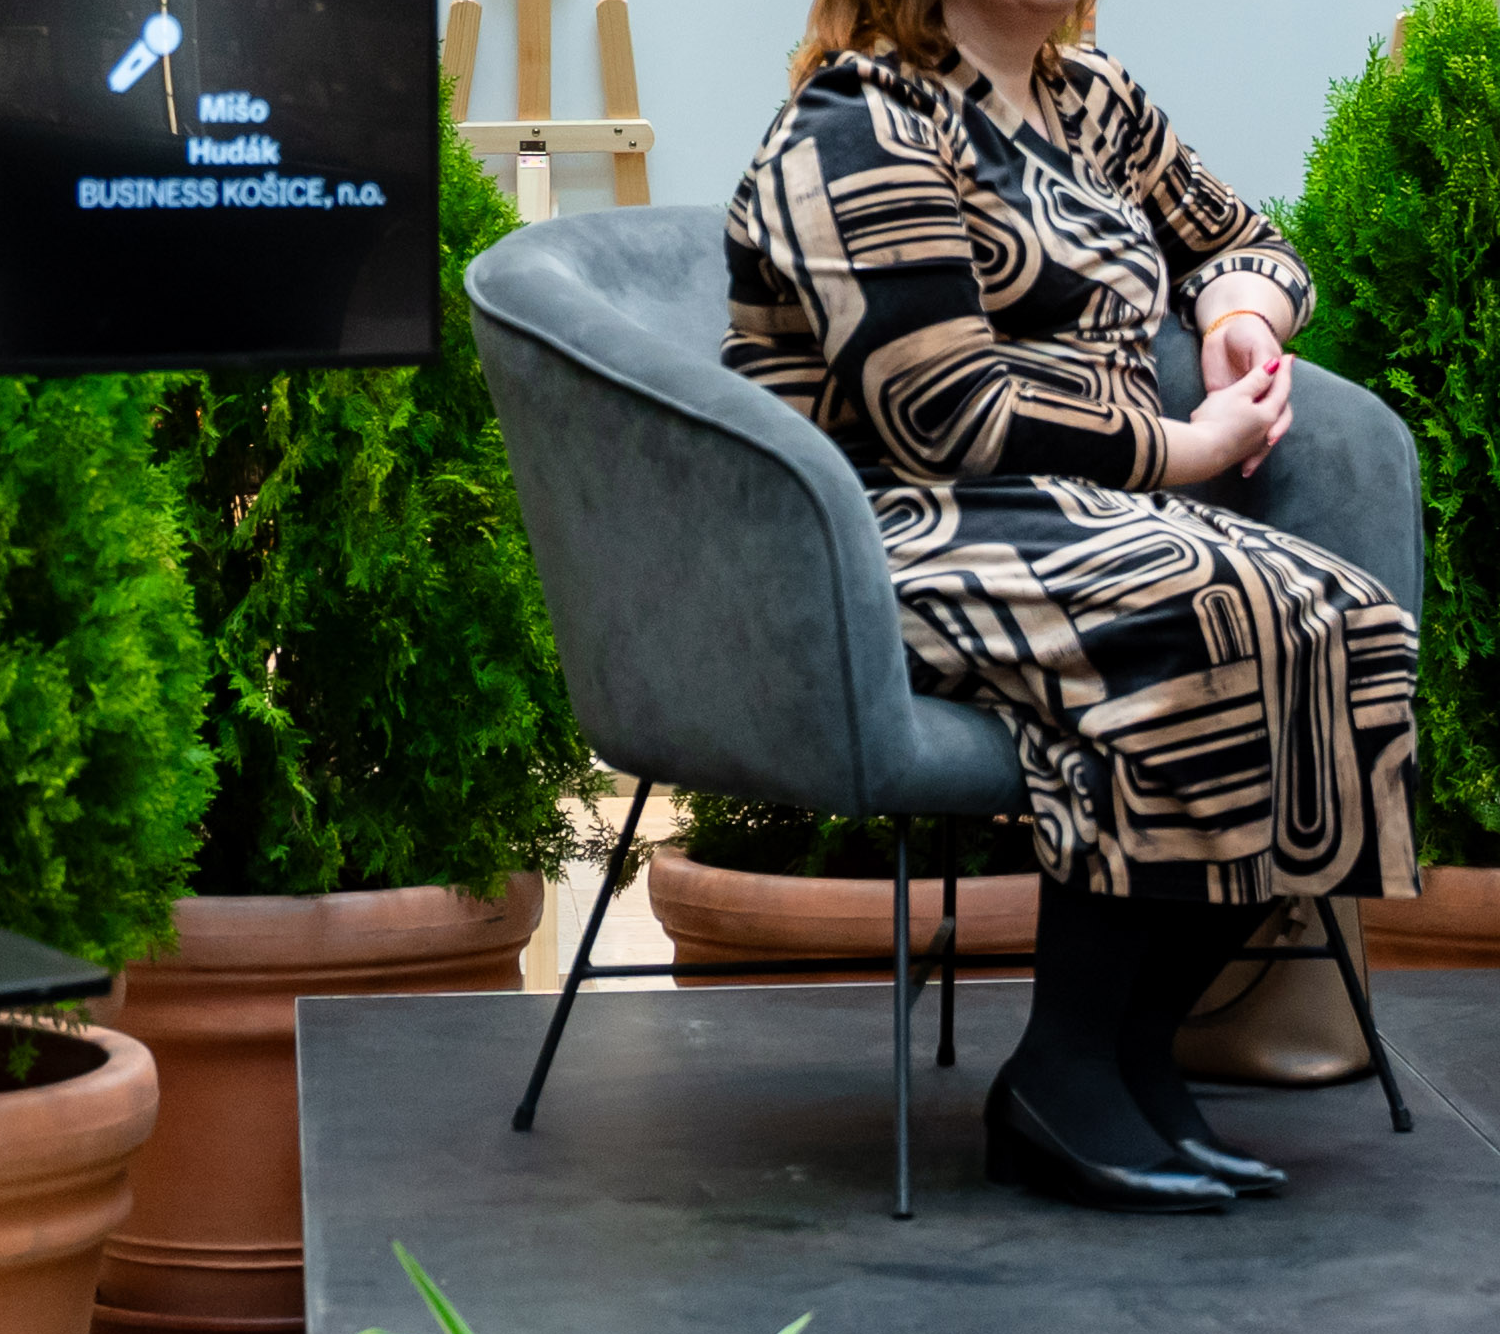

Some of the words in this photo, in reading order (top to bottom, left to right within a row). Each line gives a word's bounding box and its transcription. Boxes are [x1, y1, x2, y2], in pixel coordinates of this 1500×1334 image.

[198, 92, 271, 124] Mišo
[187, 134, 282, 165] Hudák
[78, 177, 218, 208] BUSINESS
[222, 171, 334, 210] KOŠICE,
[337, 182, 386, 206] n.o.
